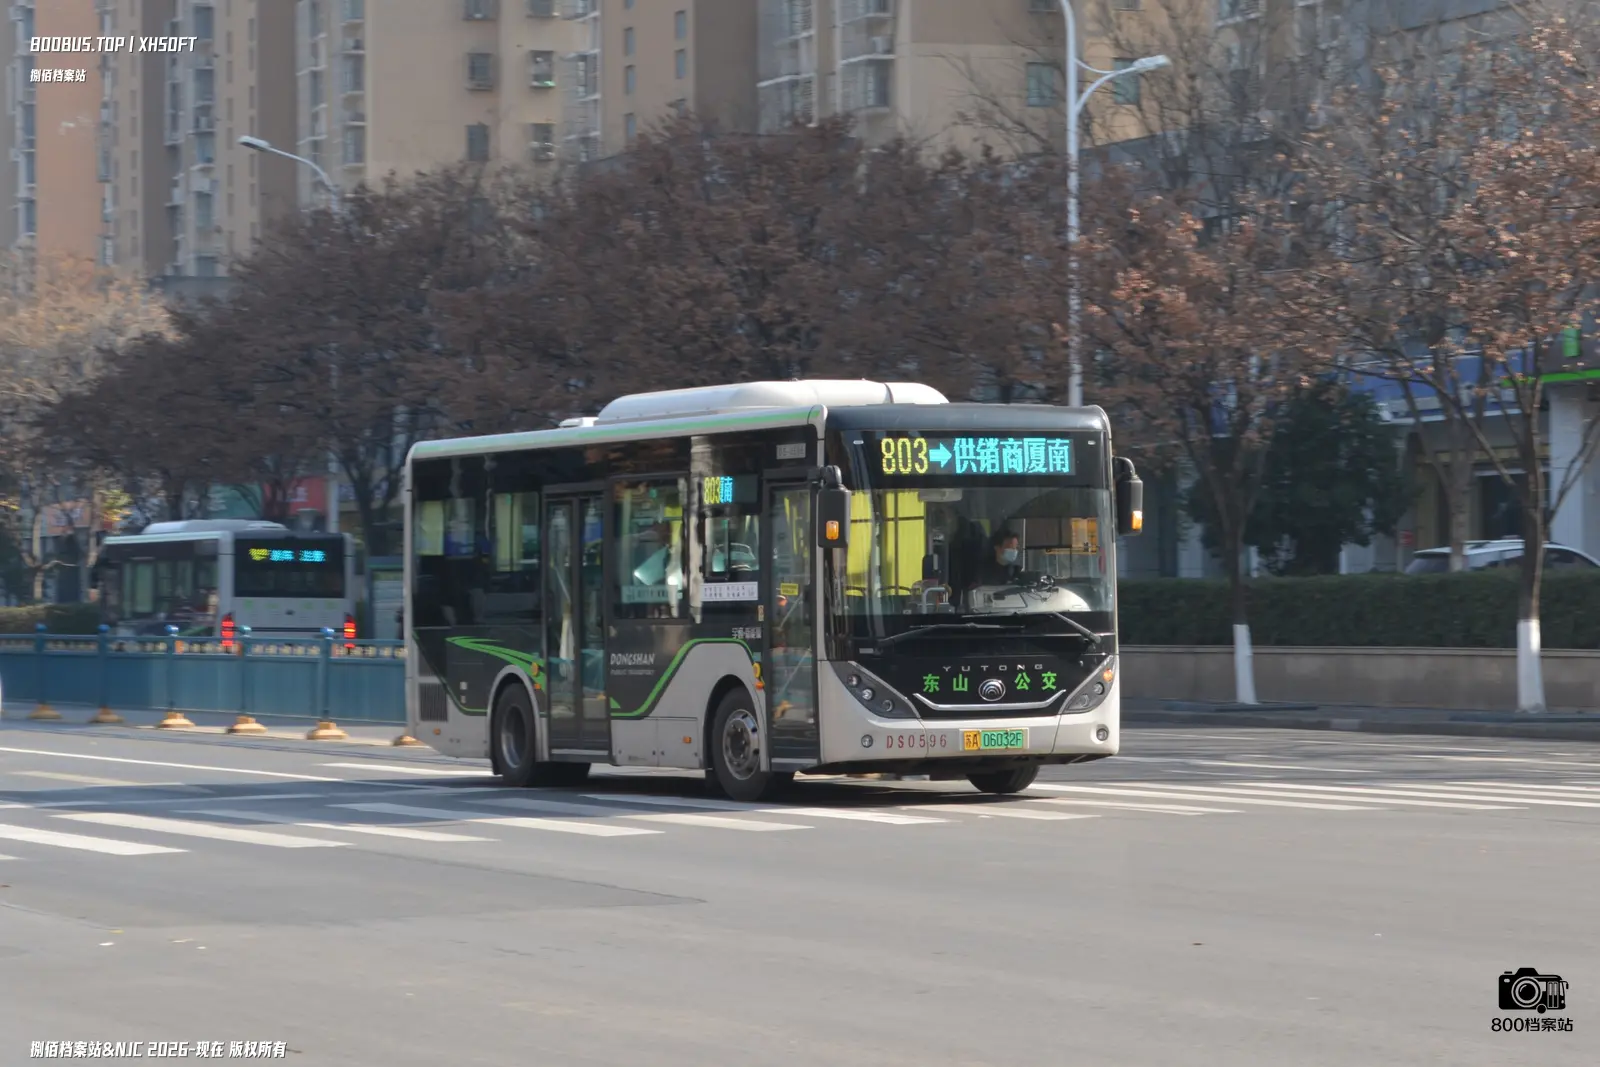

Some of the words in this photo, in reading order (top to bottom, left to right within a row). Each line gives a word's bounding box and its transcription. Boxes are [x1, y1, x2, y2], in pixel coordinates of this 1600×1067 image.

[881, 437, 929, 474] 803
[953, 437, 1070, 474] 供销商厦南
[610, 653, 655, 666] DONGSHAN
[942, 664, 1043, 672] YUTONG
[922, 673, 969, 693] 东山
[1014, 671, 1058, 691] 公交
[886, 734, 948, 749] DS0596
[983, 732, 1022, 747] 06032F
